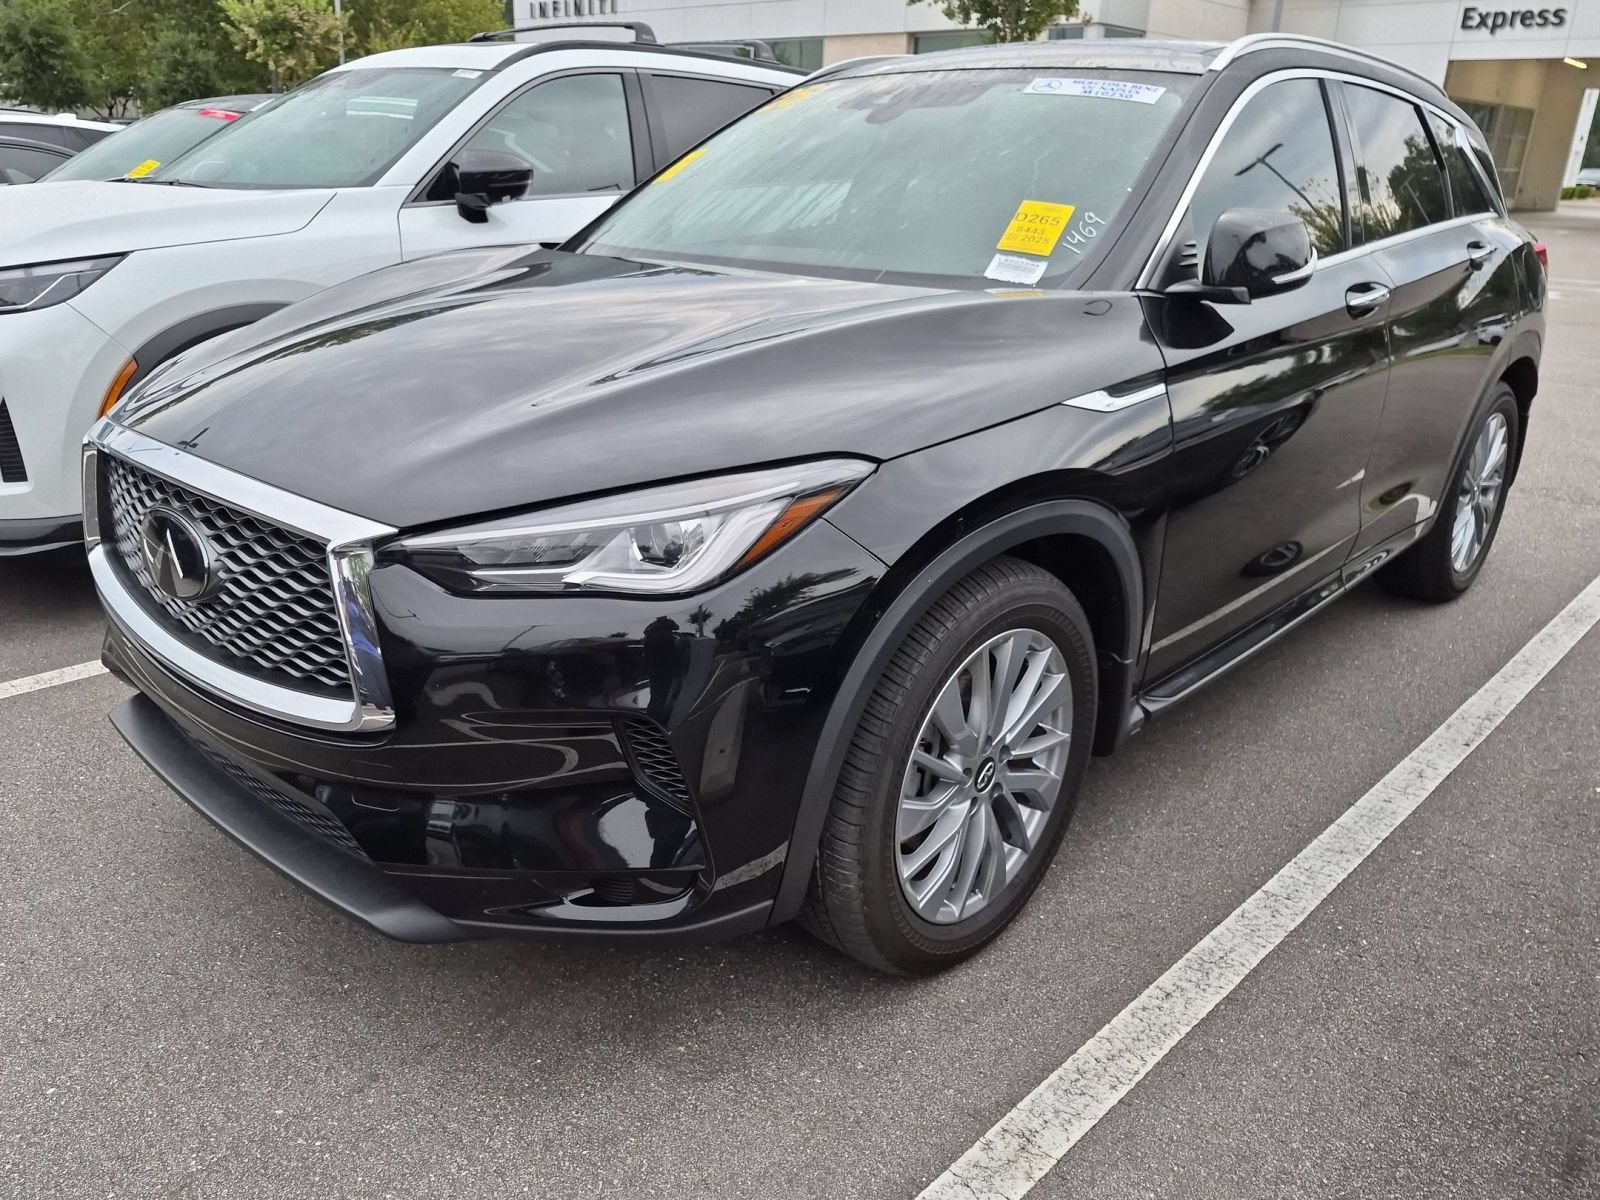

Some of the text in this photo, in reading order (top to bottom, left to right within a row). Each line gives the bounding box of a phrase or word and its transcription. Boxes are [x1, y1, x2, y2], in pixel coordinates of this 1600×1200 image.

[529, 0, 618, 19] INFINITI
[1461, 7, 1567, 35] Express
[1015, 212, 1062, 226] D265
[1016, 226, 1046, 236] 8443
[1062, 212, 1106, 254] 1469
[1020, 235, 1050, 245] 2025
